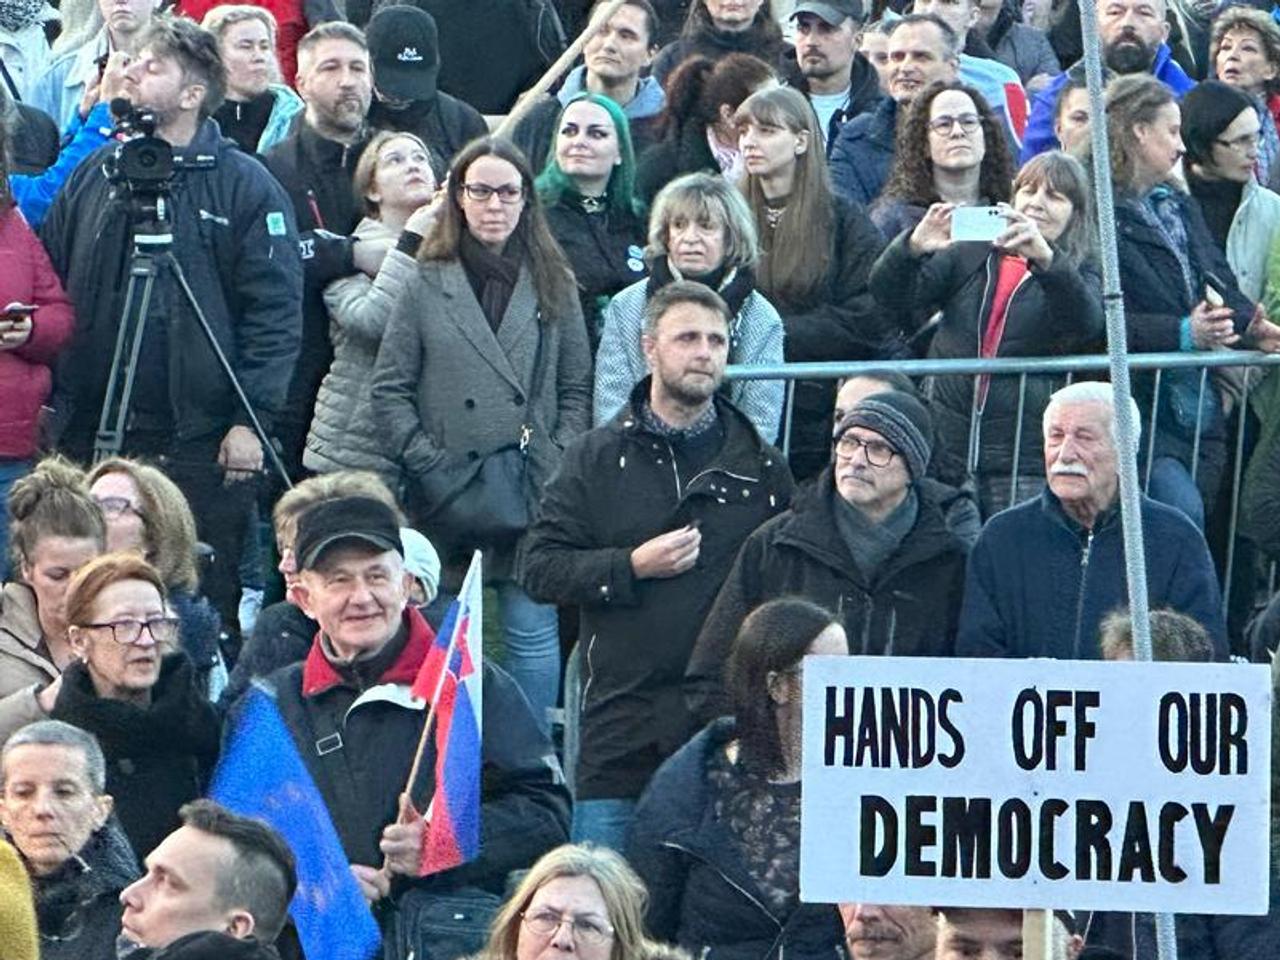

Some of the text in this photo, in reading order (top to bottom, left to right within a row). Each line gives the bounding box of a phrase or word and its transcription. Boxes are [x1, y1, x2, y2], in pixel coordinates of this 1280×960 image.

[824, 685, 1248, 776] HANDS OFF OUR
[859, 794, 1236, 885] DEMOCRACY
